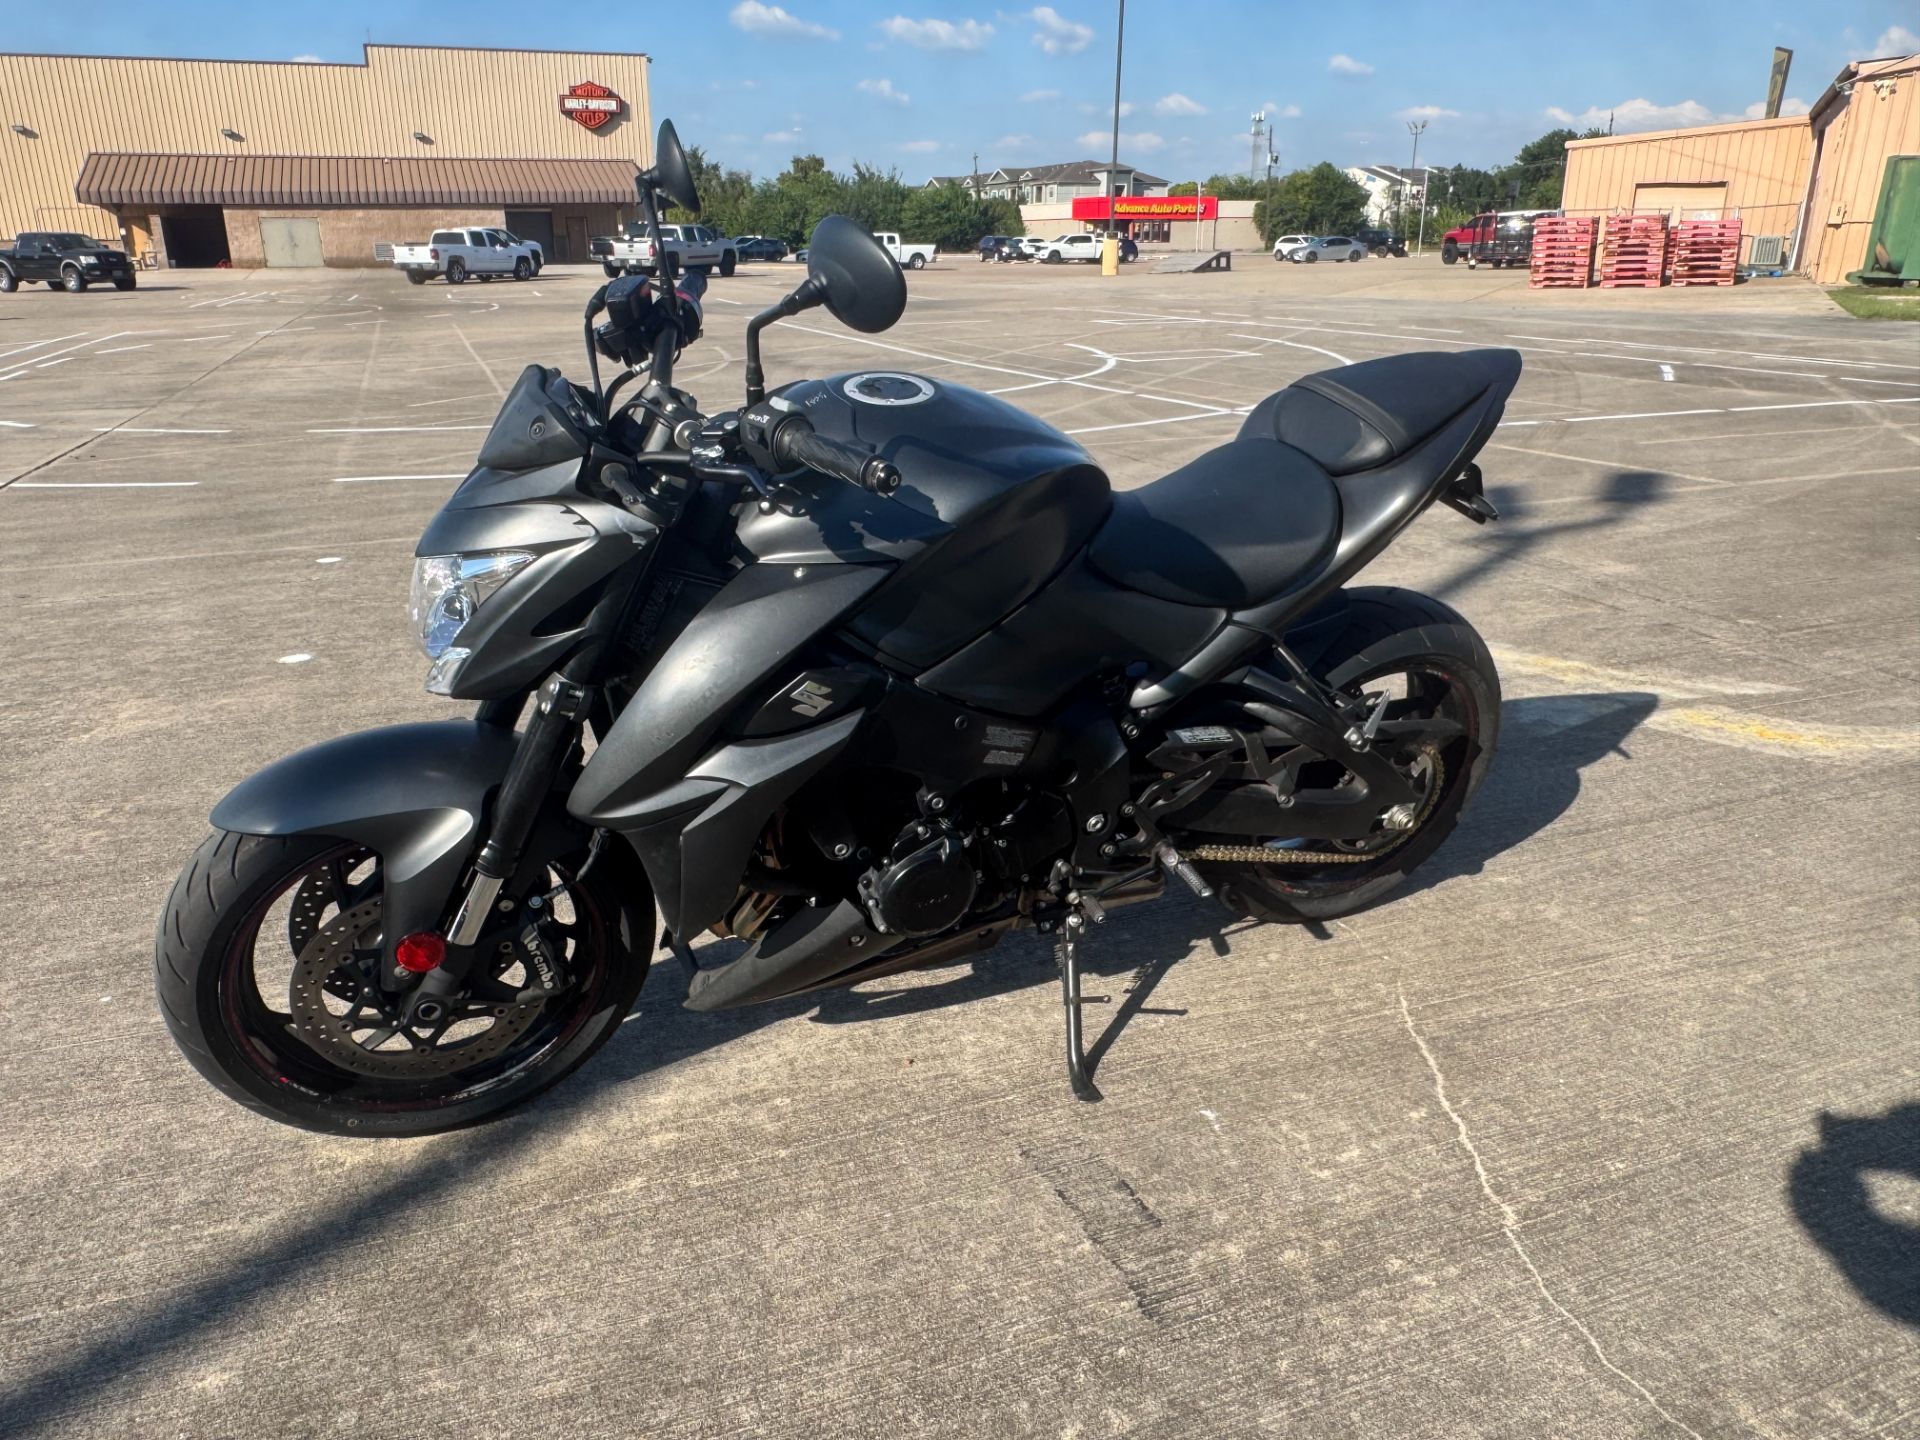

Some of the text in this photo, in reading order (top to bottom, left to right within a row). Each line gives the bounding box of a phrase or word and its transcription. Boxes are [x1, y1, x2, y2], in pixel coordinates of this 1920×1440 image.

[1114, 203, 1196, 213] Advance Auto Parts
[527, 940, 553, 989] brembo
